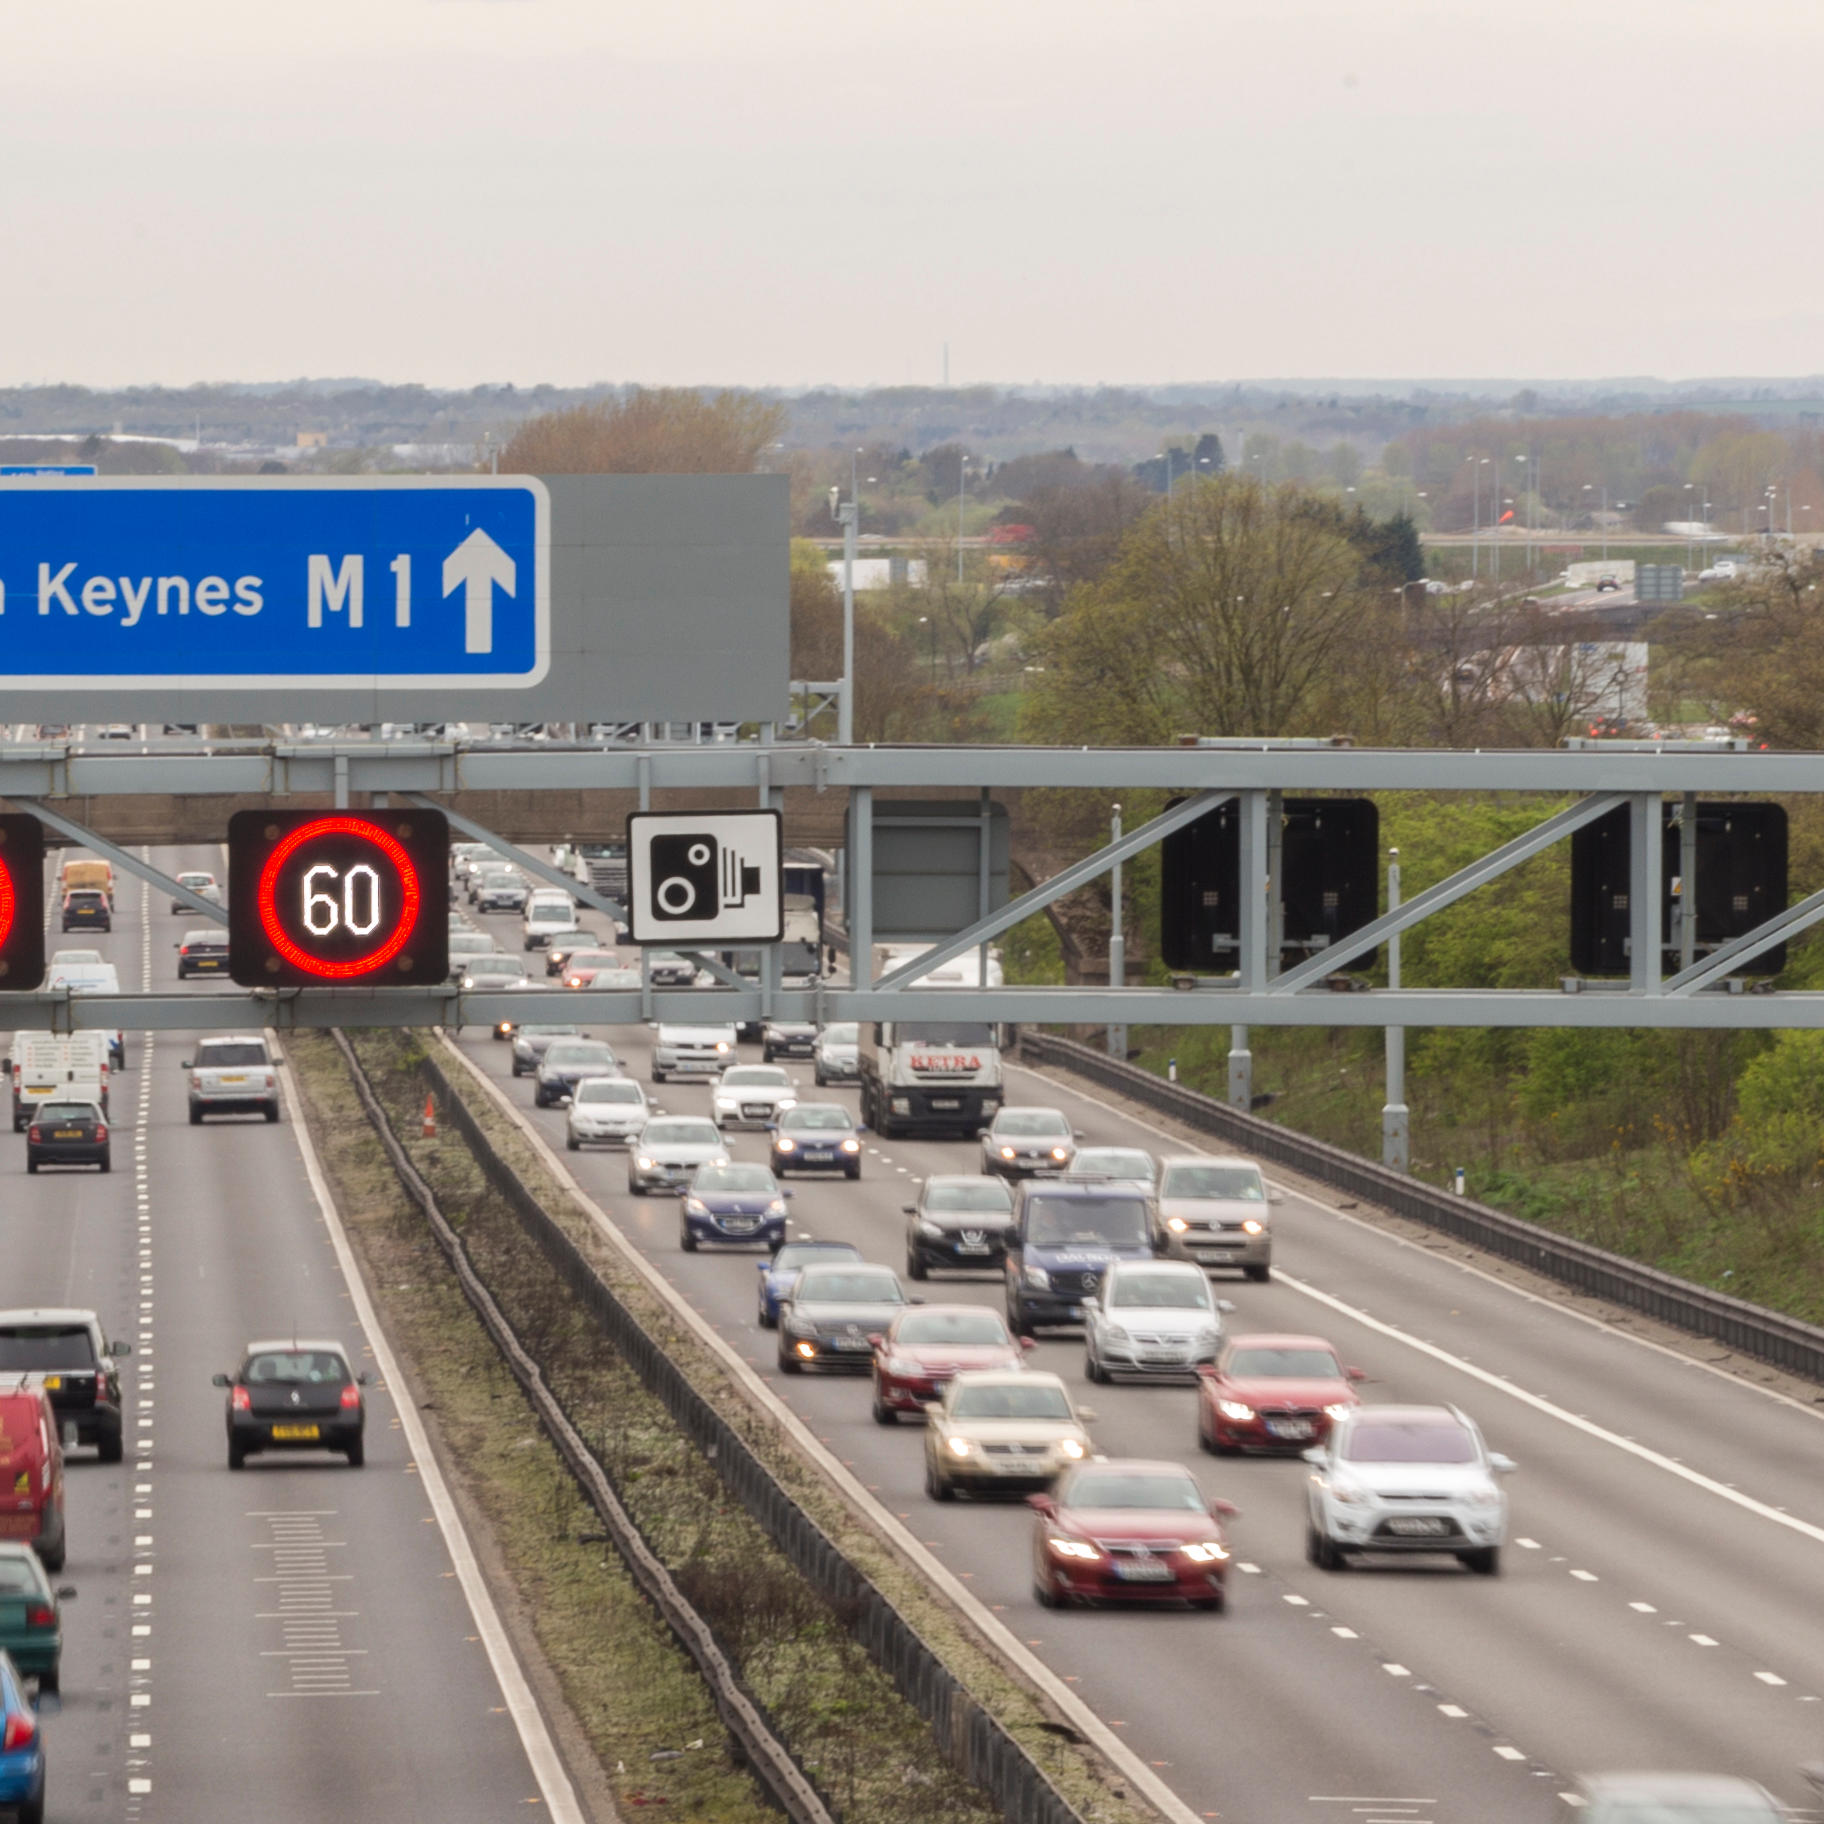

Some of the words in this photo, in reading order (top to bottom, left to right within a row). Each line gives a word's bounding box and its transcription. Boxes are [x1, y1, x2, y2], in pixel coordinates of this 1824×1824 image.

[37, 562, 263, 627] Keynes
[308, 554, 412, 628] M1
[302, 863, 381, 936] 60
